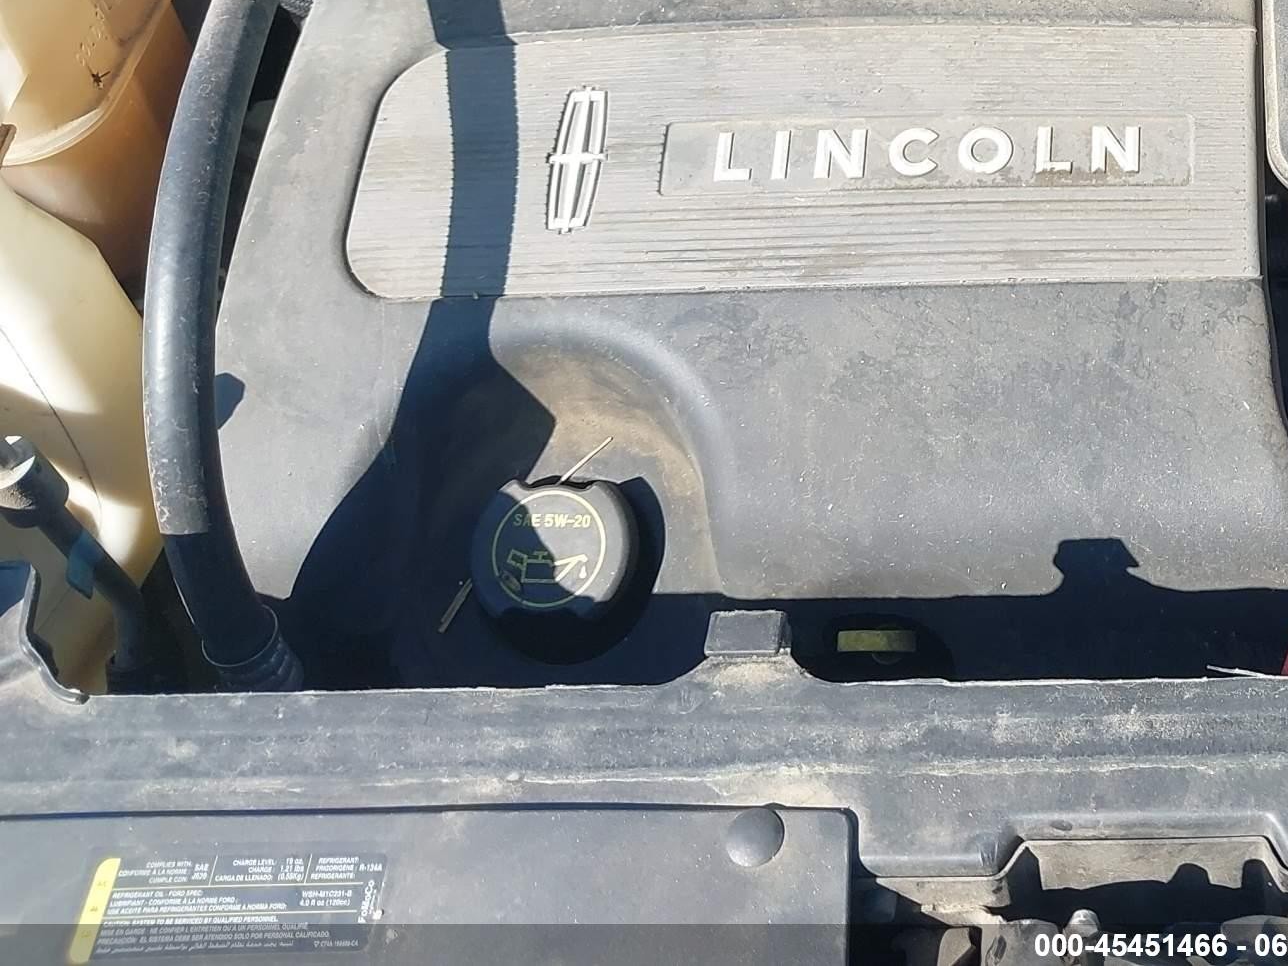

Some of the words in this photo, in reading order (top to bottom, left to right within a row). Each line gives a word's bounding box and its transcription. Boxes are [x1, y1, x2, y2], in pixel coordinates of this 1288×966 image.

[713, 125, 1140, 182] LINCOLN
[512, 513, 541, 528] SAE
[543, 513, 591, 528] 5W-20
